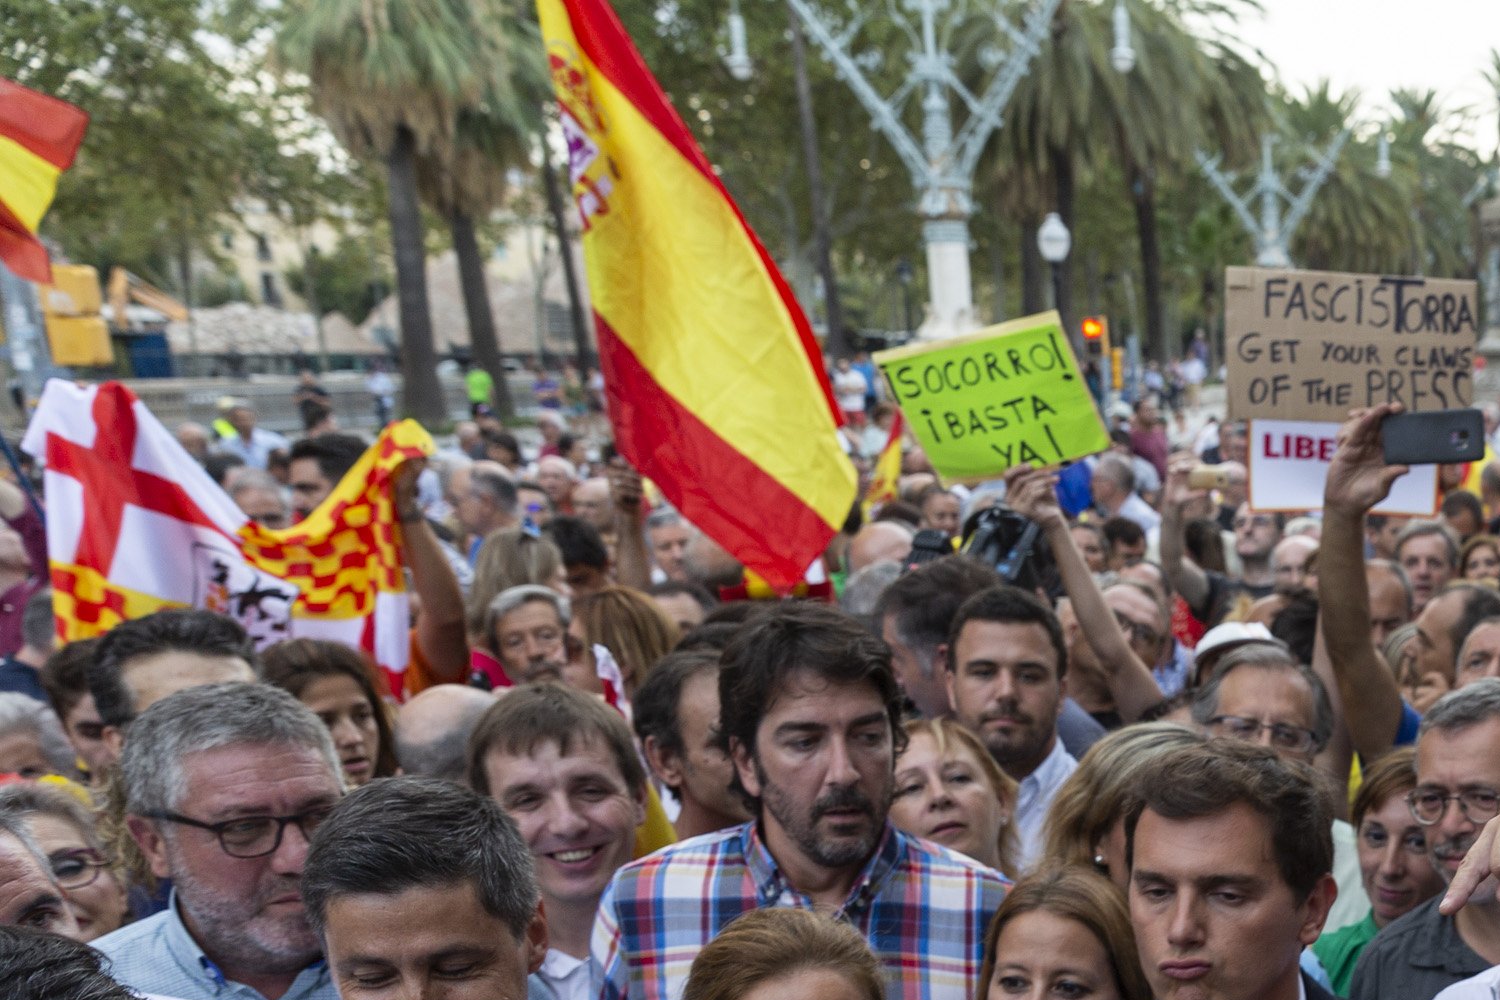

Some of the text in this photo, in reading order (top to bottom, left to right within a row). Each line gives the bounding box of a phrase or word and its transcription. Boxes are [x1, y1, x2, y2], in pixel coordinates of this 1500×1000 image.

[1237, 332, 1473, 370] GET YOUR CLAWS
[1249, 374, 1292, 407] OF
[1302, 377, 1352, 407] THE
[1263, 432, 1337, 463] LIBE
